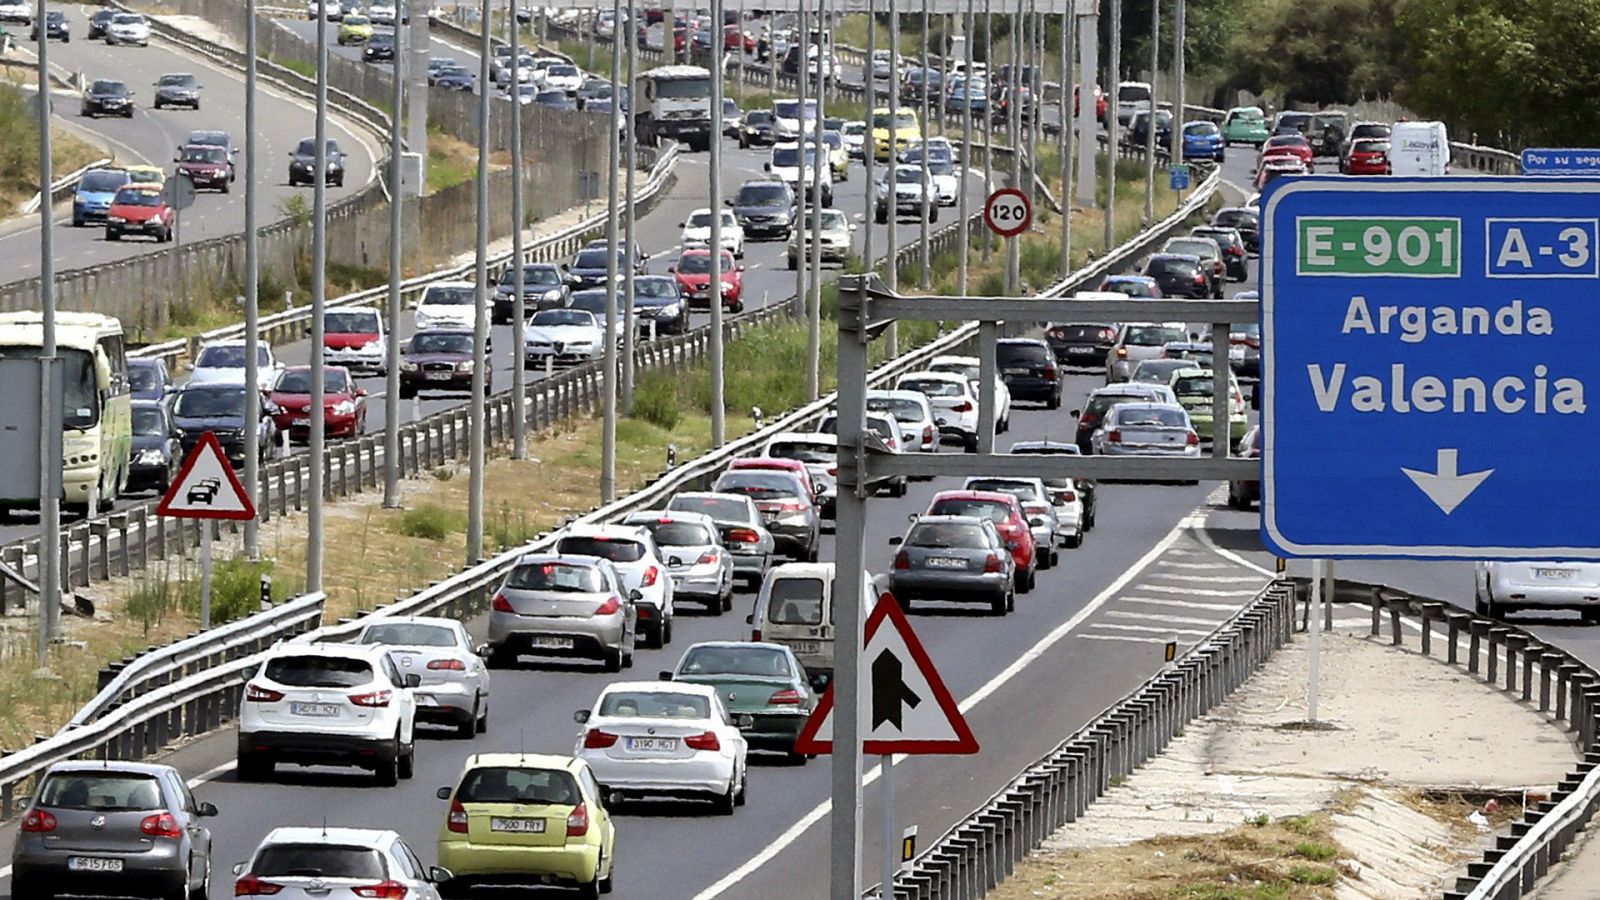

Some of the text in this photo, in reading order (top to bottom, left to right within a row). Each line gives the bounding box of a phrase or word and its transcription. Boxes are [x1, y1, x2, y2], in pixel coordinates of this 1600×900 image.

[1527, 154, 1547, 165] Por
[993, 204, 1024, 220] 120
[1306, 225, 1590, 268] E-901 A-3
[1341, 296, 1553, 343] Arganda
[1307, 363, 1587, 414] Valencia
